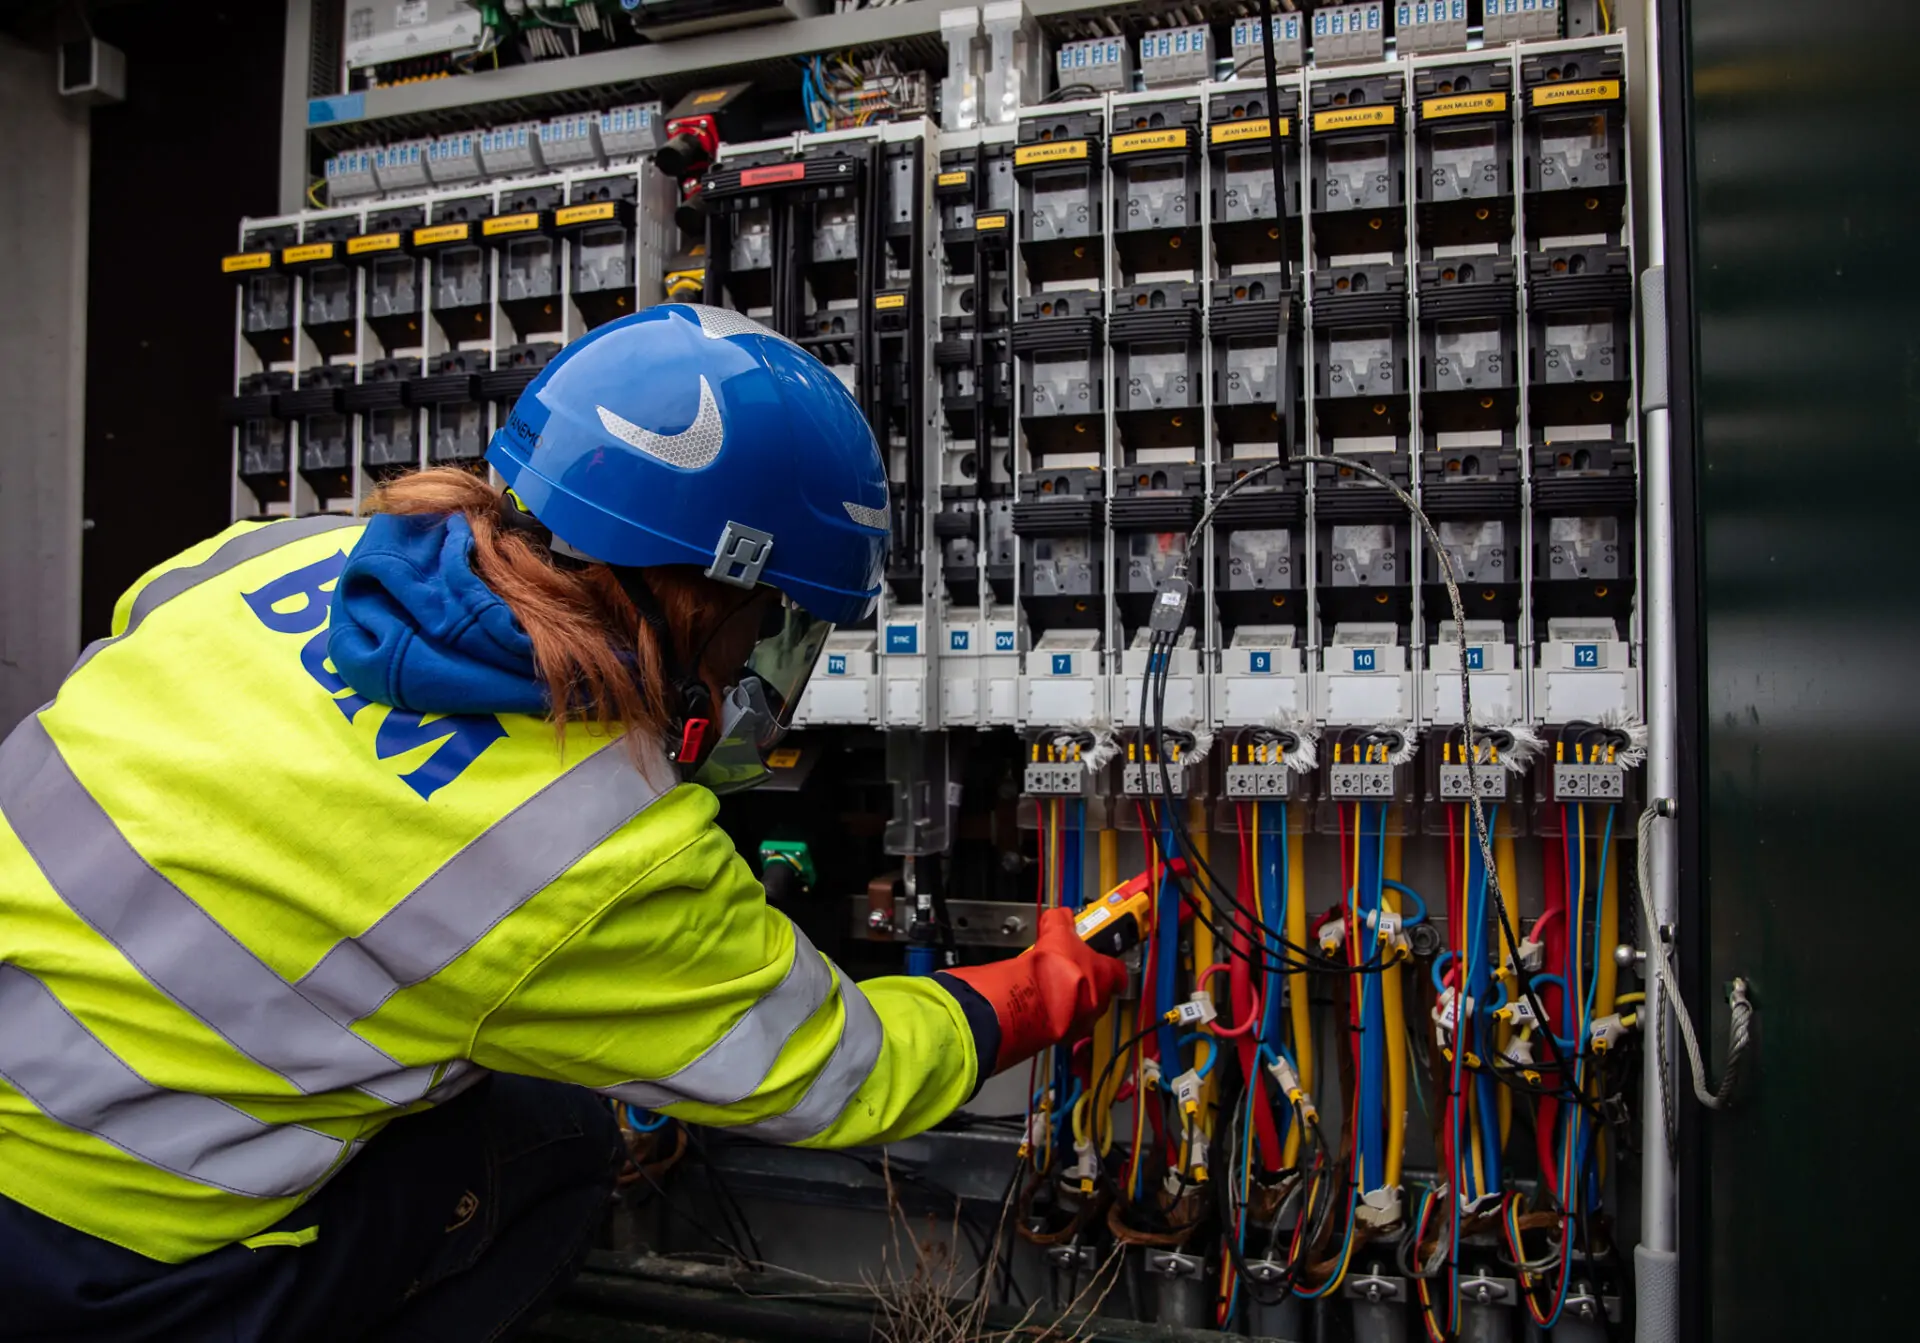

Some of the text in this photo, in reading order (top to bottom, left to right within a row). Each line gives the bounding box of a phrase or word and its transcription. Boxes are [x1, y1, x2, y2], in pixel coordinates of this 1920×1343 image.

[1545, 91, 1564, 99] JEAN
[954, 635, 966, 645] IV
[996, 635, 1013, 646] OV
[1256, 656, 1264, 667] 9
[1357, 655, 1372, 666] 10
[1467, 653, 1479, 664] 11
[1578, 651, 1594, 662] 12
[830, 659, 844, 670] TR
[1057, 659, 1065, 669] 7
